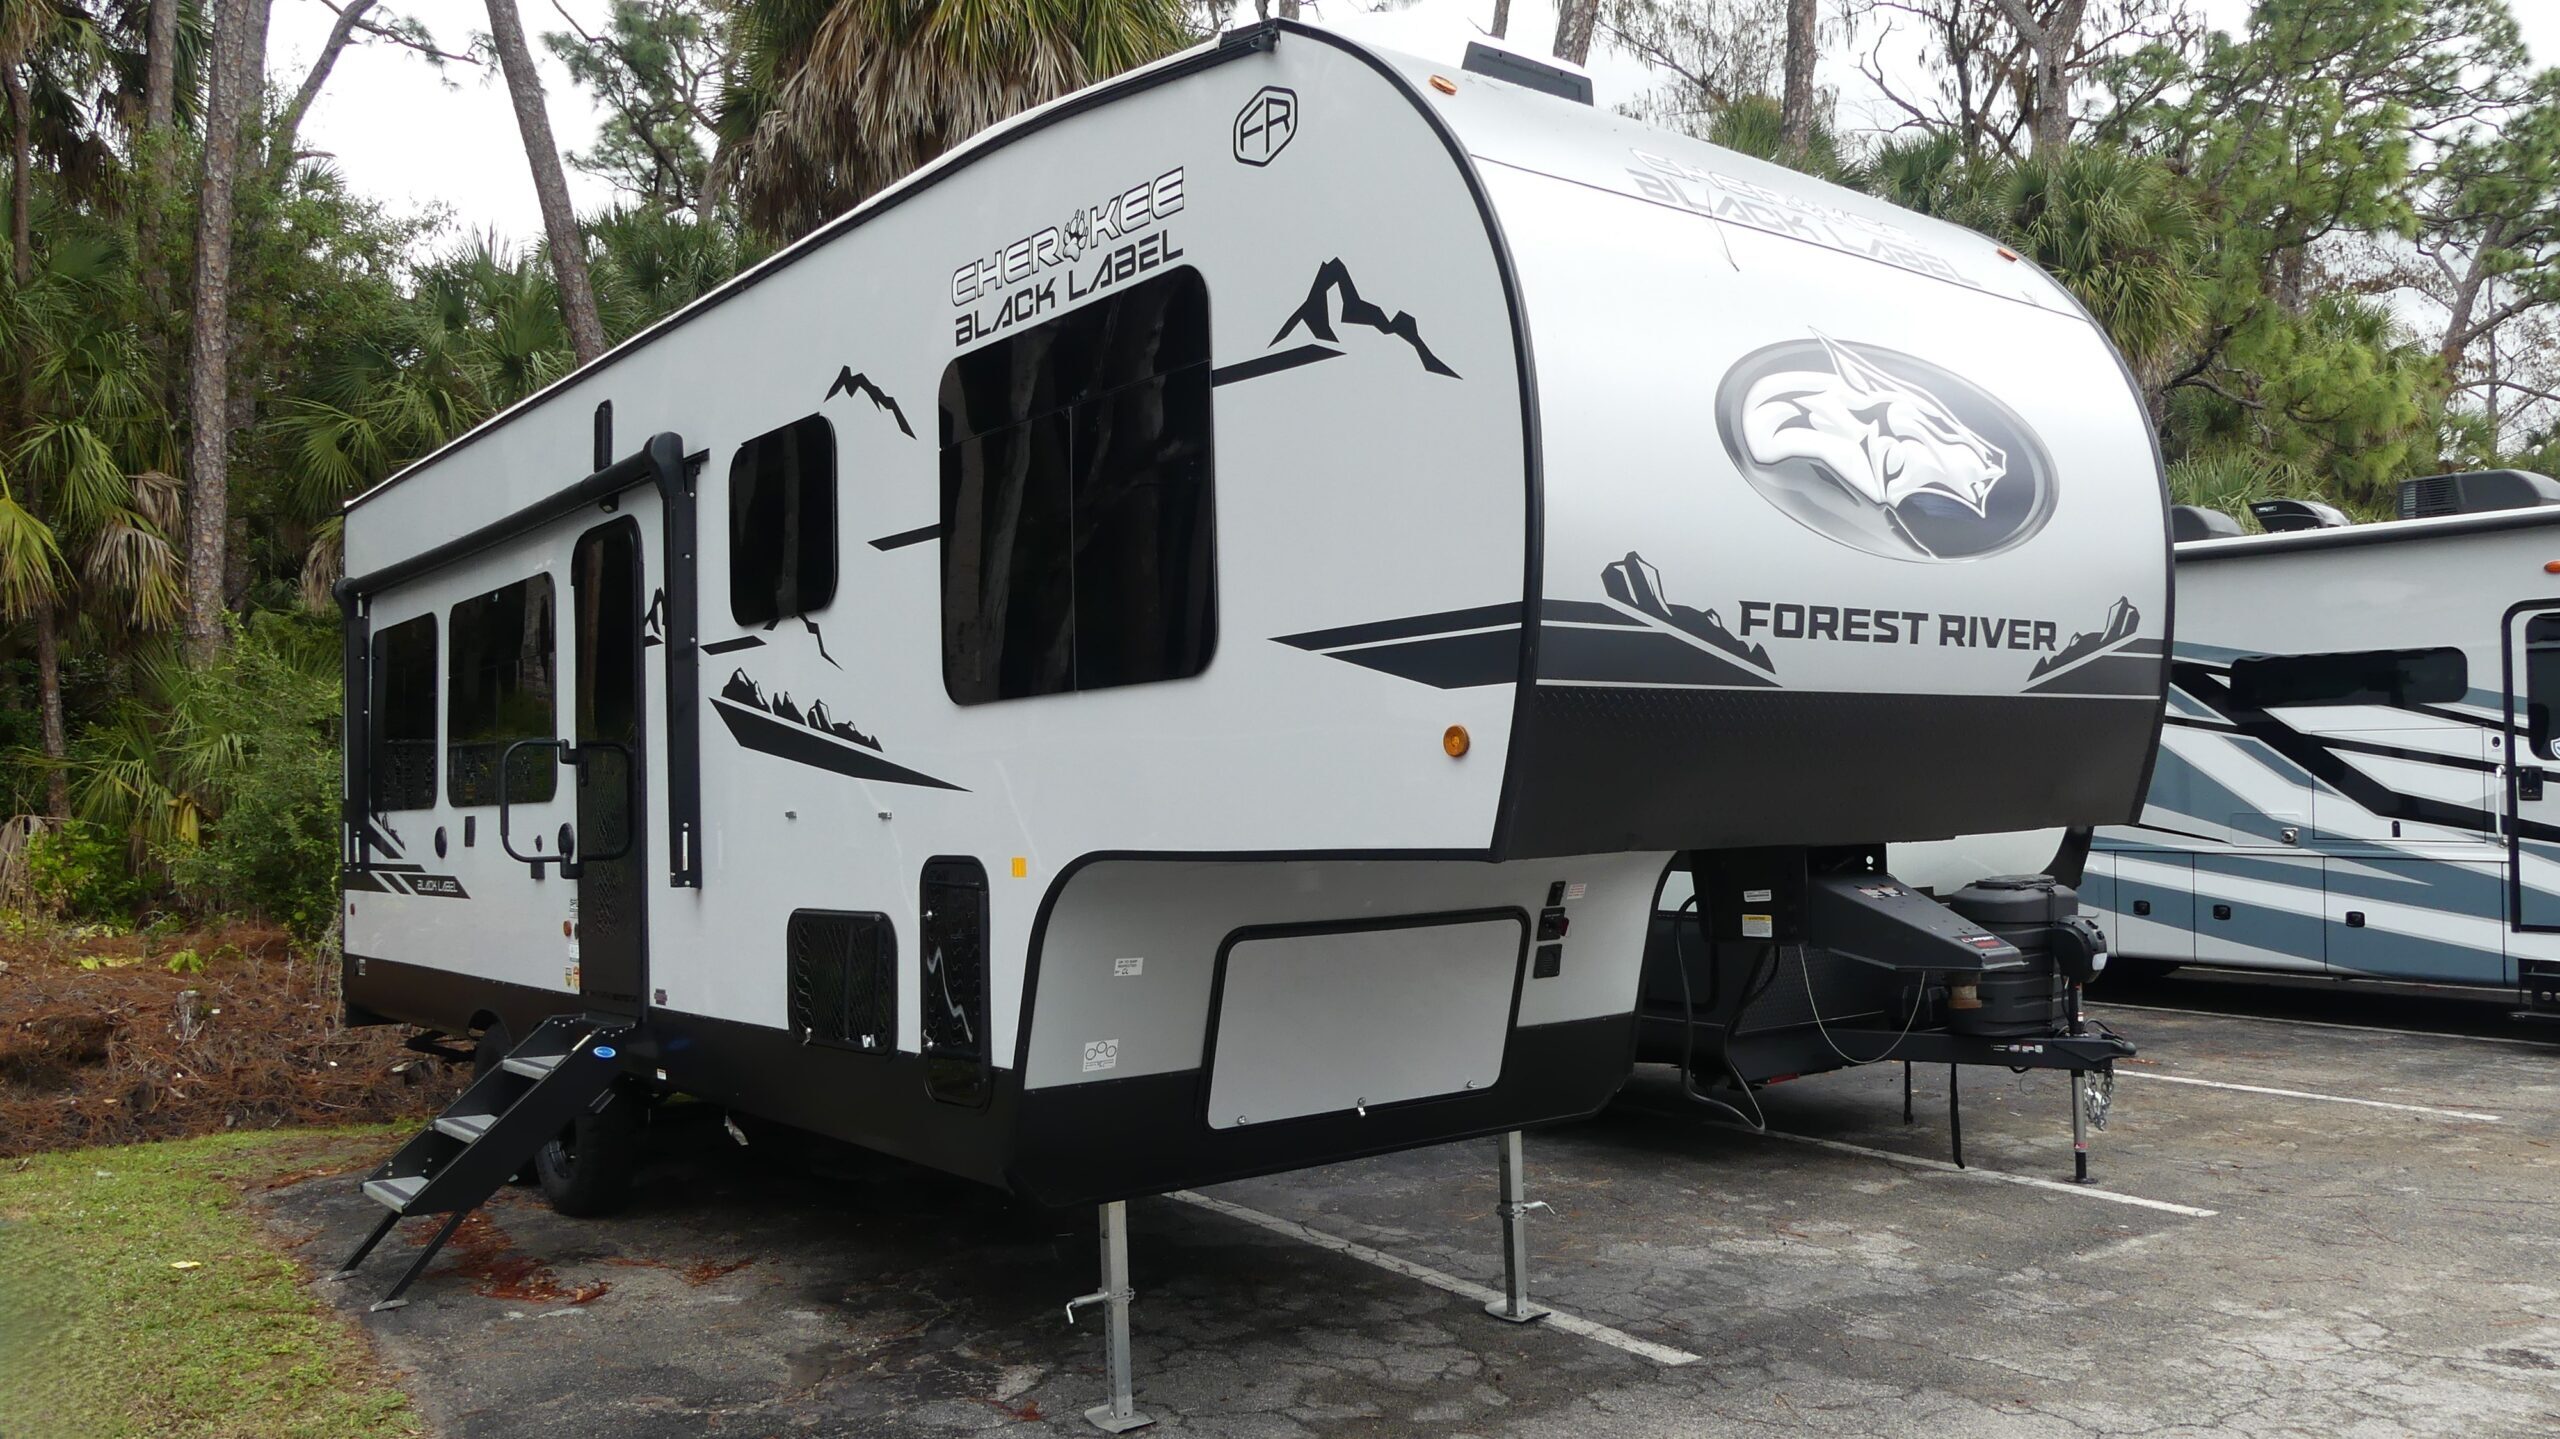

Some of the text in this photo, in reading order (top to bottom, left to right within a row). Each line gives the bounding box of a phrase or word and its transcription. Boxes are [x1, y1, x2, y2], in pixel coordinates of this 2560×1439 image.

[1625, 167, 1982, 287] BLACK LABEL
[955, 229, 1184, 347] BLACK LABEL
[1738, 600, 2057, 652] FOREST RIVER
